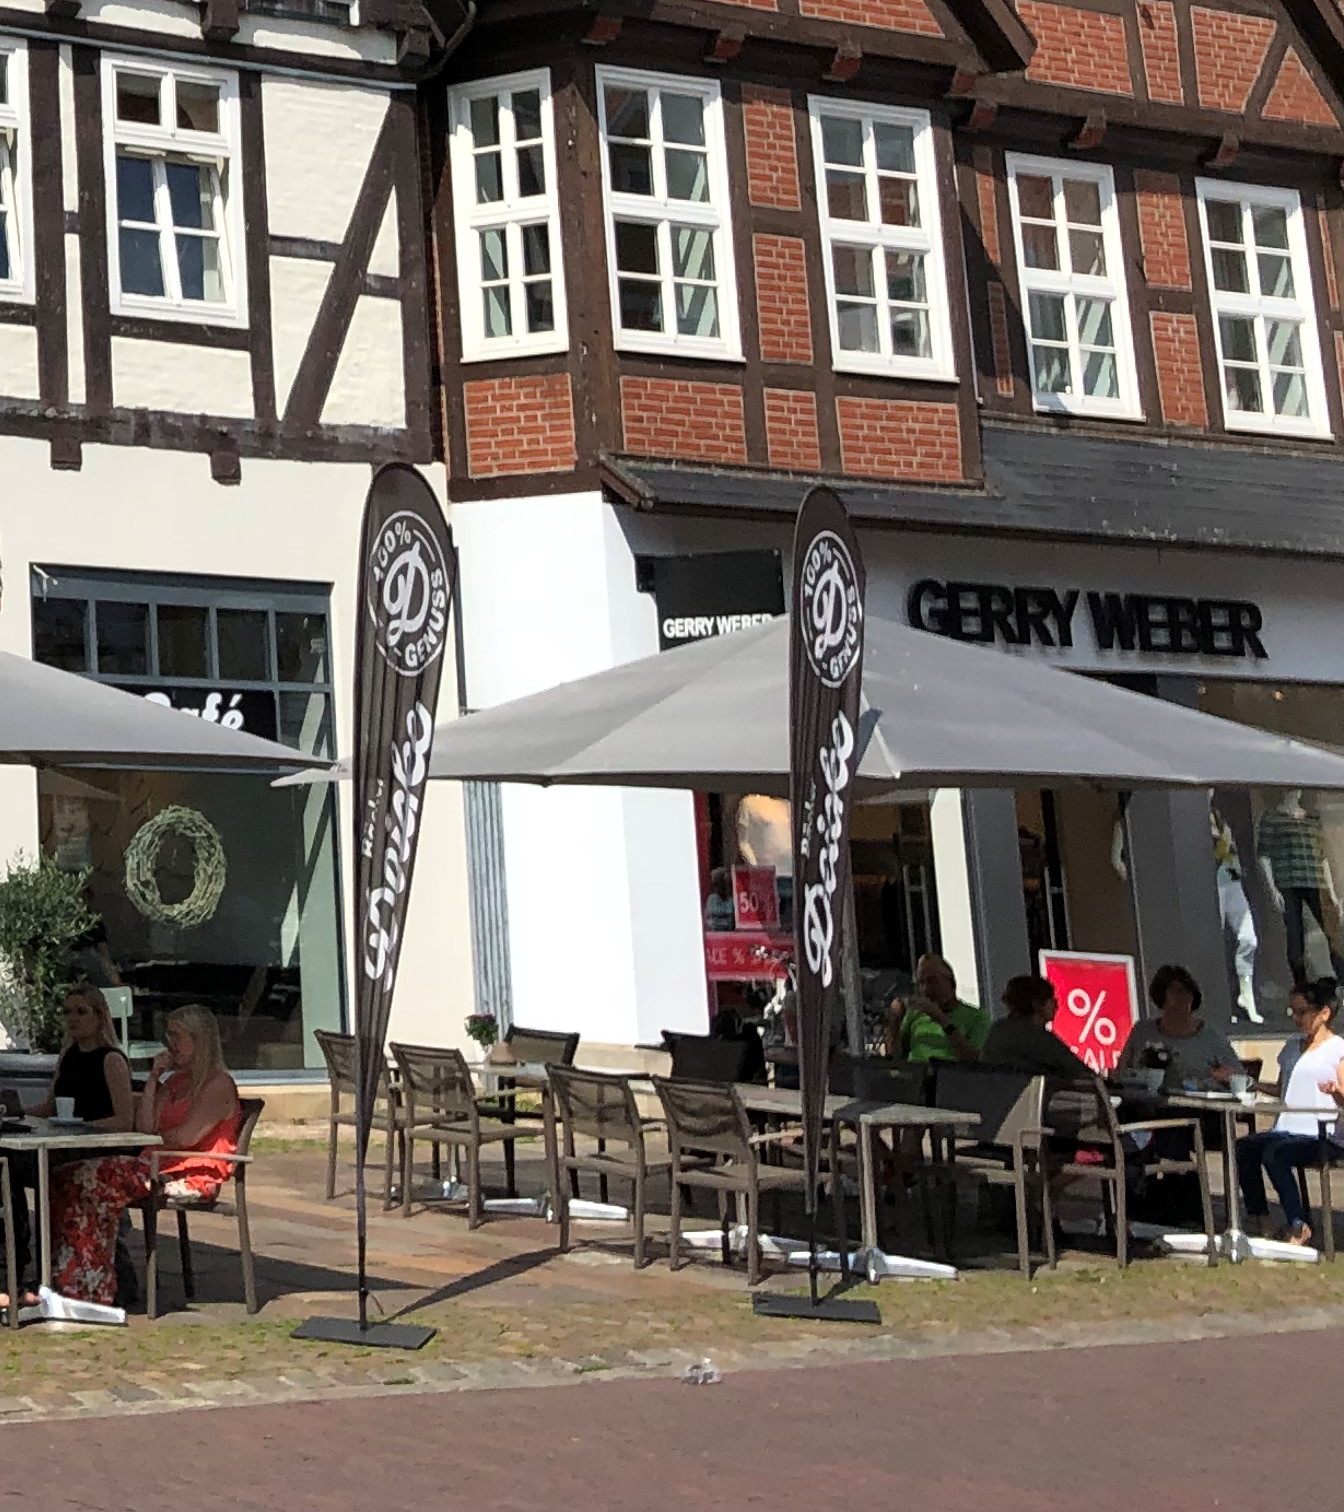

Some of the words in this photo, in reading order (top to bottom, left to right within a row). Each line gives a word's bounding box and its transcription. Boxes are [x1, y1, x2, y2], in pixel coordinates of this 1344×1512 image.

[404, 567, 445, 668] GENUSS
[663, 616, 714, 639] GERRY
[909, 579, 1079, 646] GERRY
[1088, 592, 1269, 659] WEBER
[1067, 988, 1117, 1046] %
